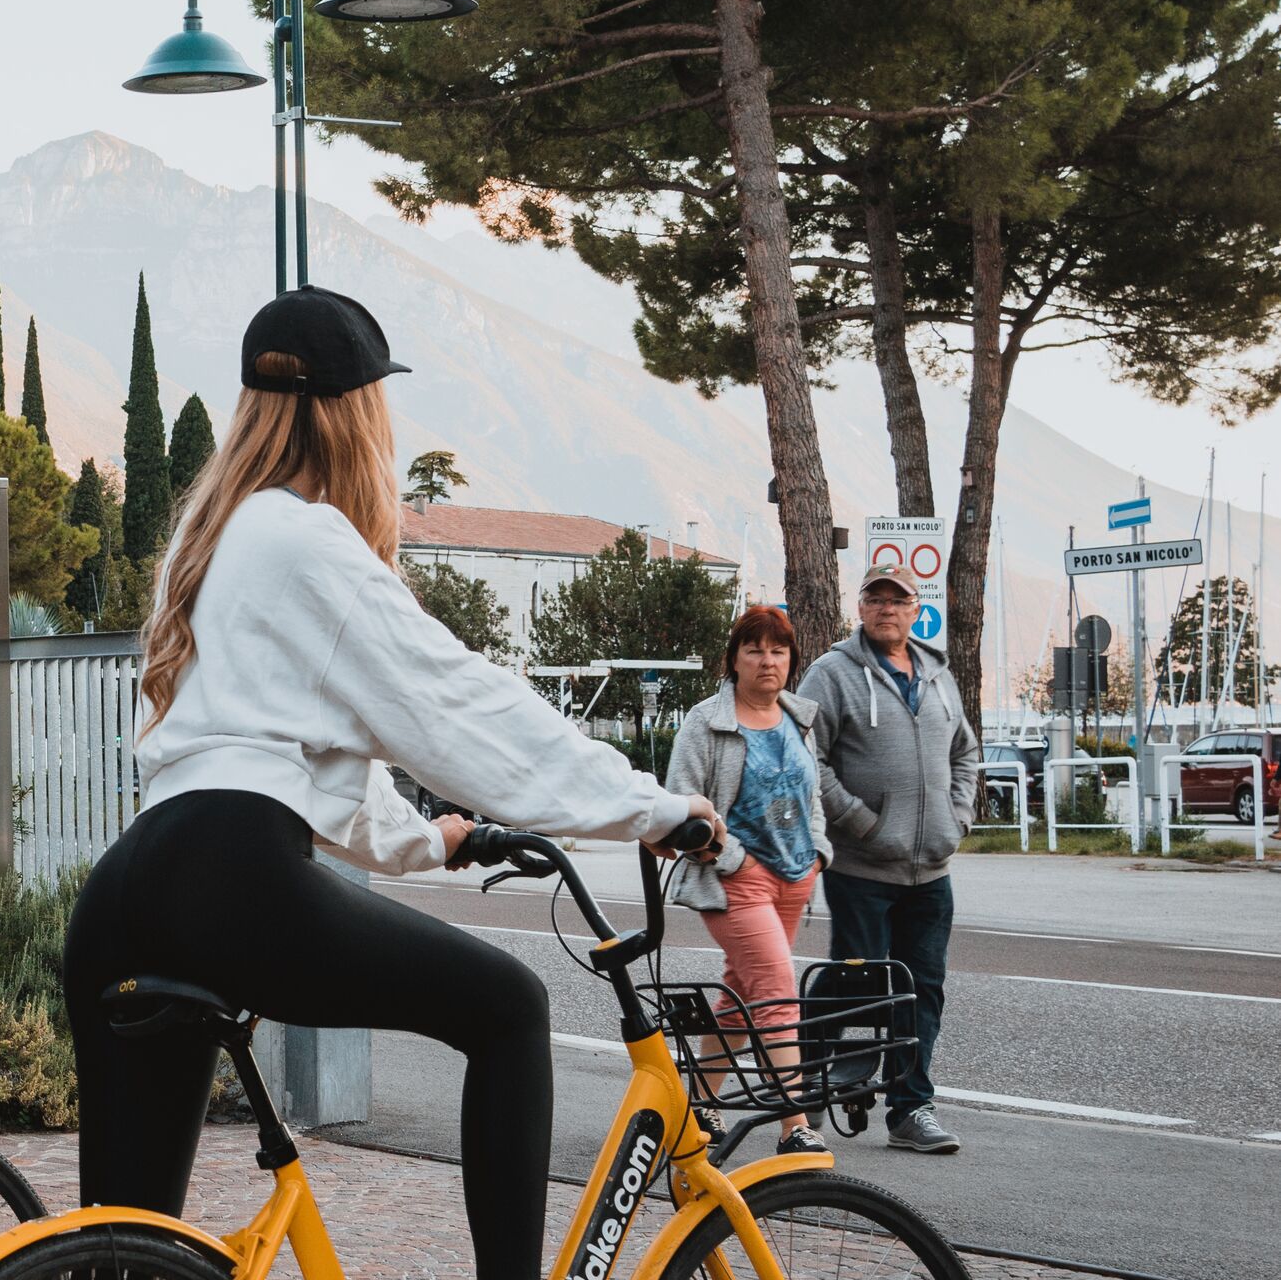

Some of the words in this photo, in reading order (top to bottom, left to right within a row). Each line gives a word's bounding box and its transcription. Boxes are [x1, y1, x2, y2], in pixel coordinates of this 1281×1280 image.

[872, 522, 894, 531] PORTO
[896, 522, 911, 531] SAN
[1073, 553, 1113, 568] PORTO
[1117, 551, 1141, 565] SAN
[119, 978, 137, 993] ofo
